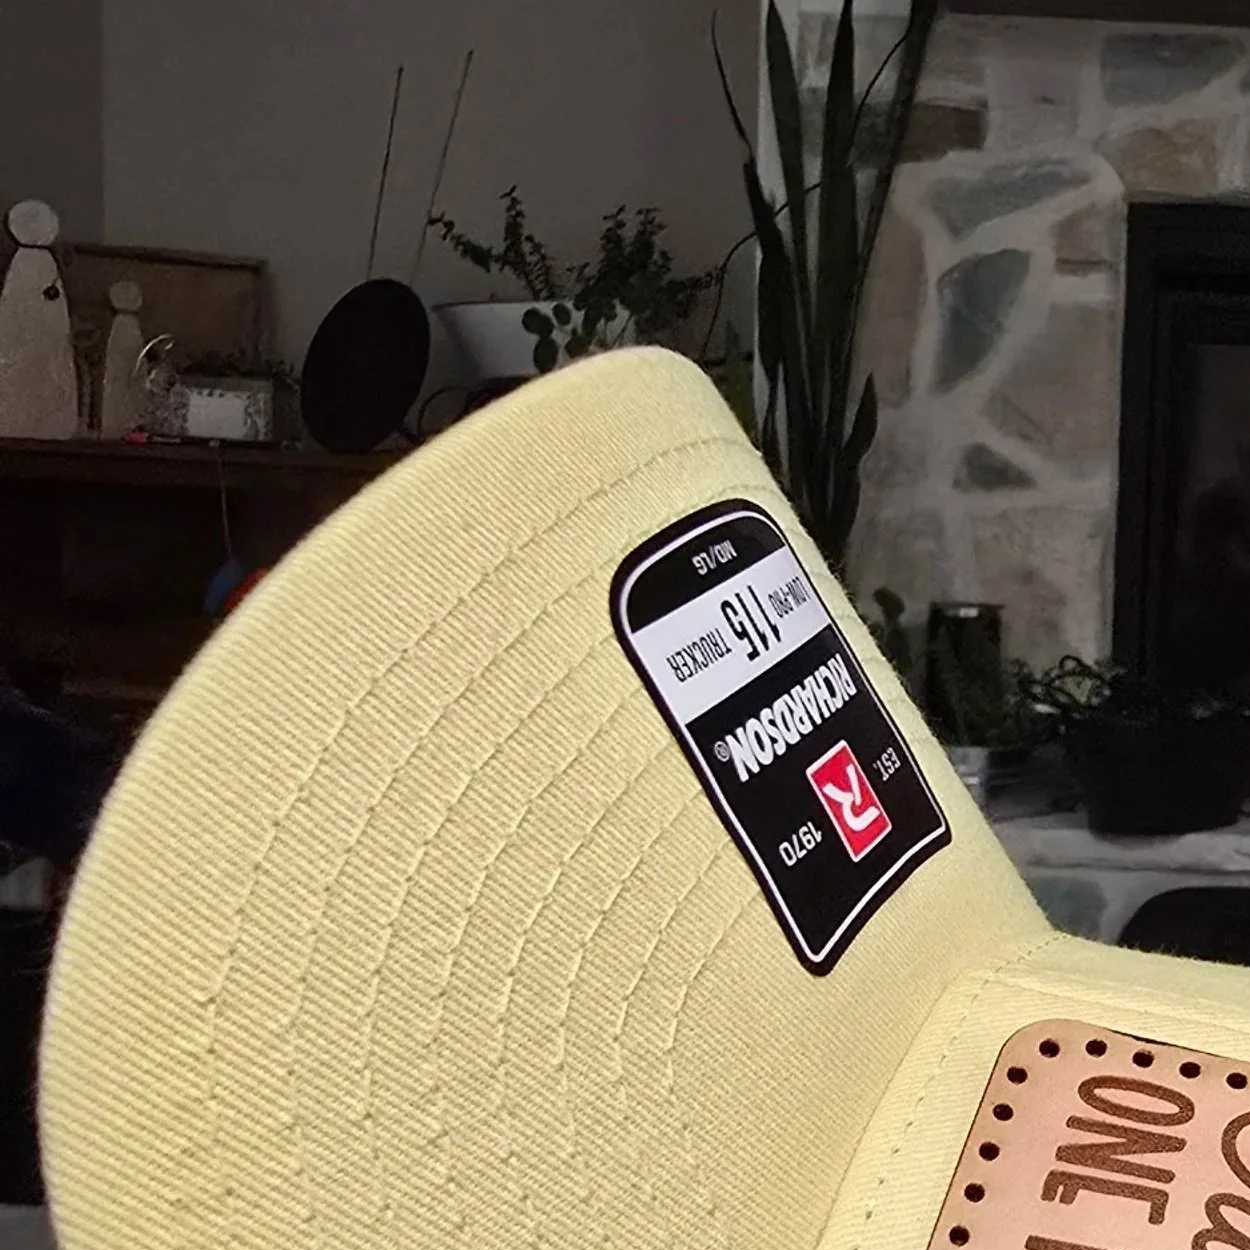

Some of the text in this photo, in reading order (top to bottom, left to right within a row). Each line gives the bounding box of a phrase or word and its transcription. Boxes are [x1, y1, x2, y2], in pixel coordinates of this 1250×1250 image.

[692, 539, 738, 576] MD/LG
[665, 576, 811, 683] LOW-PRO 115 TRUCKER
[872, 746, 900, 782] EST.
[779, 821, 823, 868] 1970
[1040, 1074, 1196, 1226] ONE
